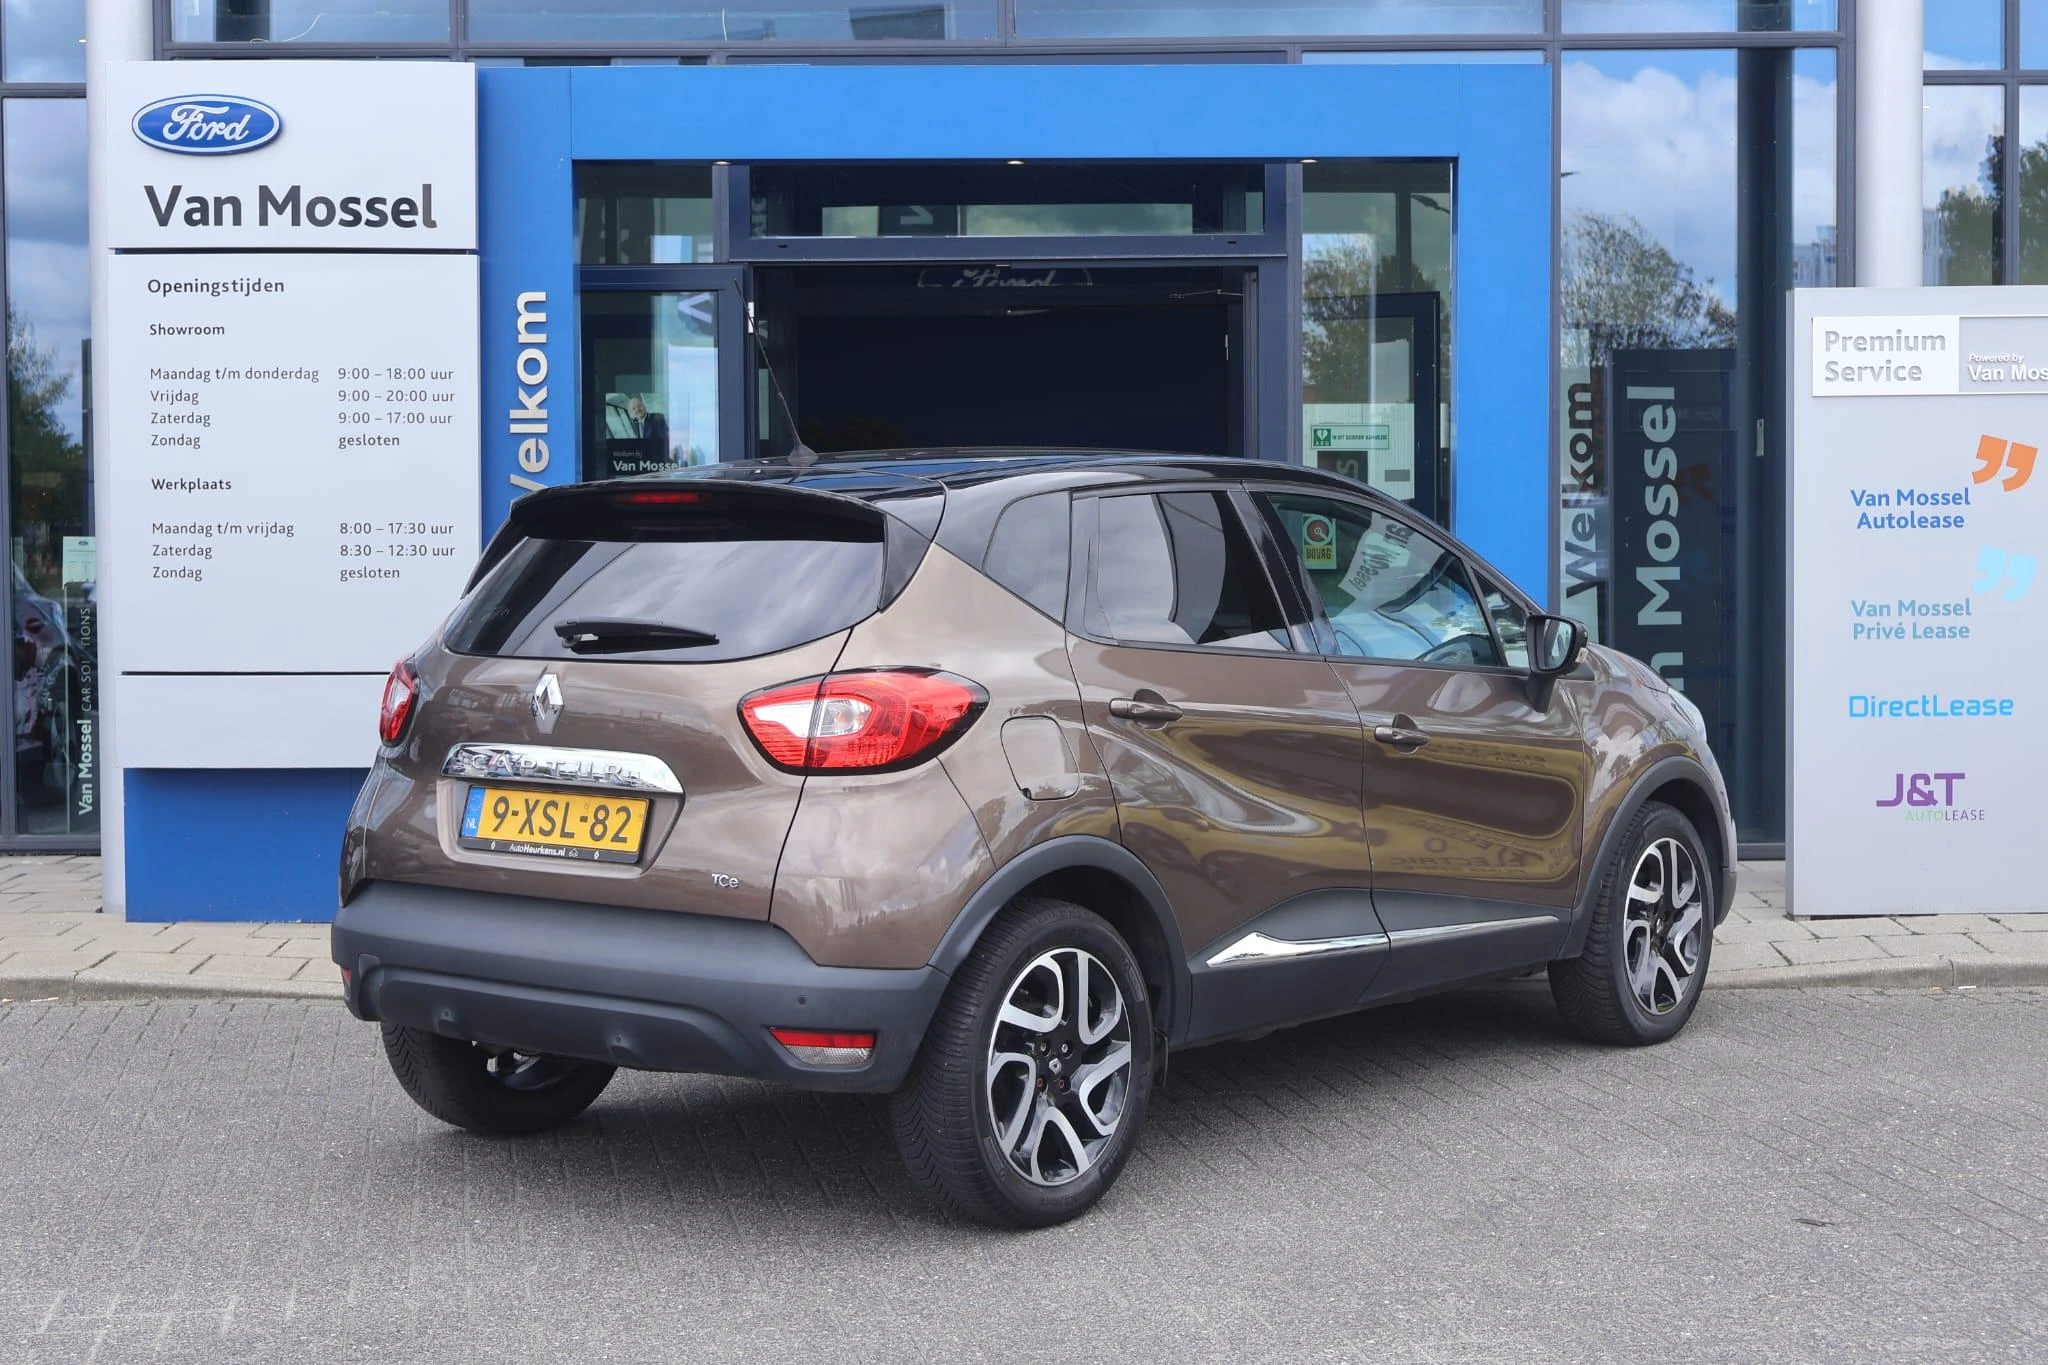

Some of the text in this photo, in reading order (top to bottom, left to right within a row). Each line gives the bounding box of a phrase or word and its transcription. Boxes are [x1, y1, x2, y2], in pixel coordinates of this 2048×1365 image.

[162, 104, 252, 142] Ford
[143, 183, 438, 229] Van Mossel
[147, 277, 285, 298] Openingstijden
[149, 323, 225, 336] Showroom
[1825, 328, 1946, 352] Premium
[1967, 353, 2025, 364] Powered by
[150, 367, 211, 384] Maandag
[215, 367, 241, 380] t/m
[244, 366, 320, 384] donderdag
[337, 367, 370, 380] 9:00
[386, 367, 426, 380] 18:00
[430, 371, 454, 380] uur
[1824, 358, 1922, 383] Service
[1968, 364, 2005, 382] Van
[150, 389, 199, 406] Vrijdag
[338, 389, 370, 402] 9:00
[386, 389, 428, 402] 20:00
[432, 393, 456, 402] uur
[509, 291, 550, 492] elkom
[151, 411, 211, 428] Zaterdag
[338, 411, 370, 424] 9:00
[386, 412, 425, 424] 17:00
[429, 415, 453, 424] uur
[151, 433, 400, 450] Zondag gesloten
[613, 460, 636, 472] Van
[151, 477, 232, 494] Werkplaats
[1562, 382, 1597, 599] Welkom
[1626, 385, 1682, 626] Mossel
[1850, 487, 1971, 507] Van Mossel
[1856, 510, 1965, 529] Autolease
[152, 521, 213, 538] Maandag
[217, 521, 242, 535] t/m
[246, 521, 295, 538] vrijdag
[339, 522, 372, 535] 8:00
[388, 522, 426, 535] 17:30
[430, 525, 455, 535] uur
[152, 543, 213, 560] Zaterdag
[340, 544, 372, 557] 8:30
[388, 544, 428, 557] 12:30
[432, 547, 456, 557] uur
[1306, 547, 1332, 560] BOVAG
[152, 565, 400, 582] Zondag gesloten
[1850, 597, 1972, 618] Van Mossel
[1853, 621, 1970, 641] Privé Lease
[81, 687, 92, 712] CAR
[1849, 694, 2014, 720] DirectLease
[76, 719, 92, 777] Mossel
[78, 778, 93, 816] Van
[1875, 772, 1966, 808] J&T
[466, 818, 477, 829] NL
[491, 795, 632, 844] 9-XSL-82
[1904, 809, 1986, 821] AUTOLEASE
[509, 843, 566, 857] AutoHeurkens.nl
[711, 873, 739, 888] TCe
